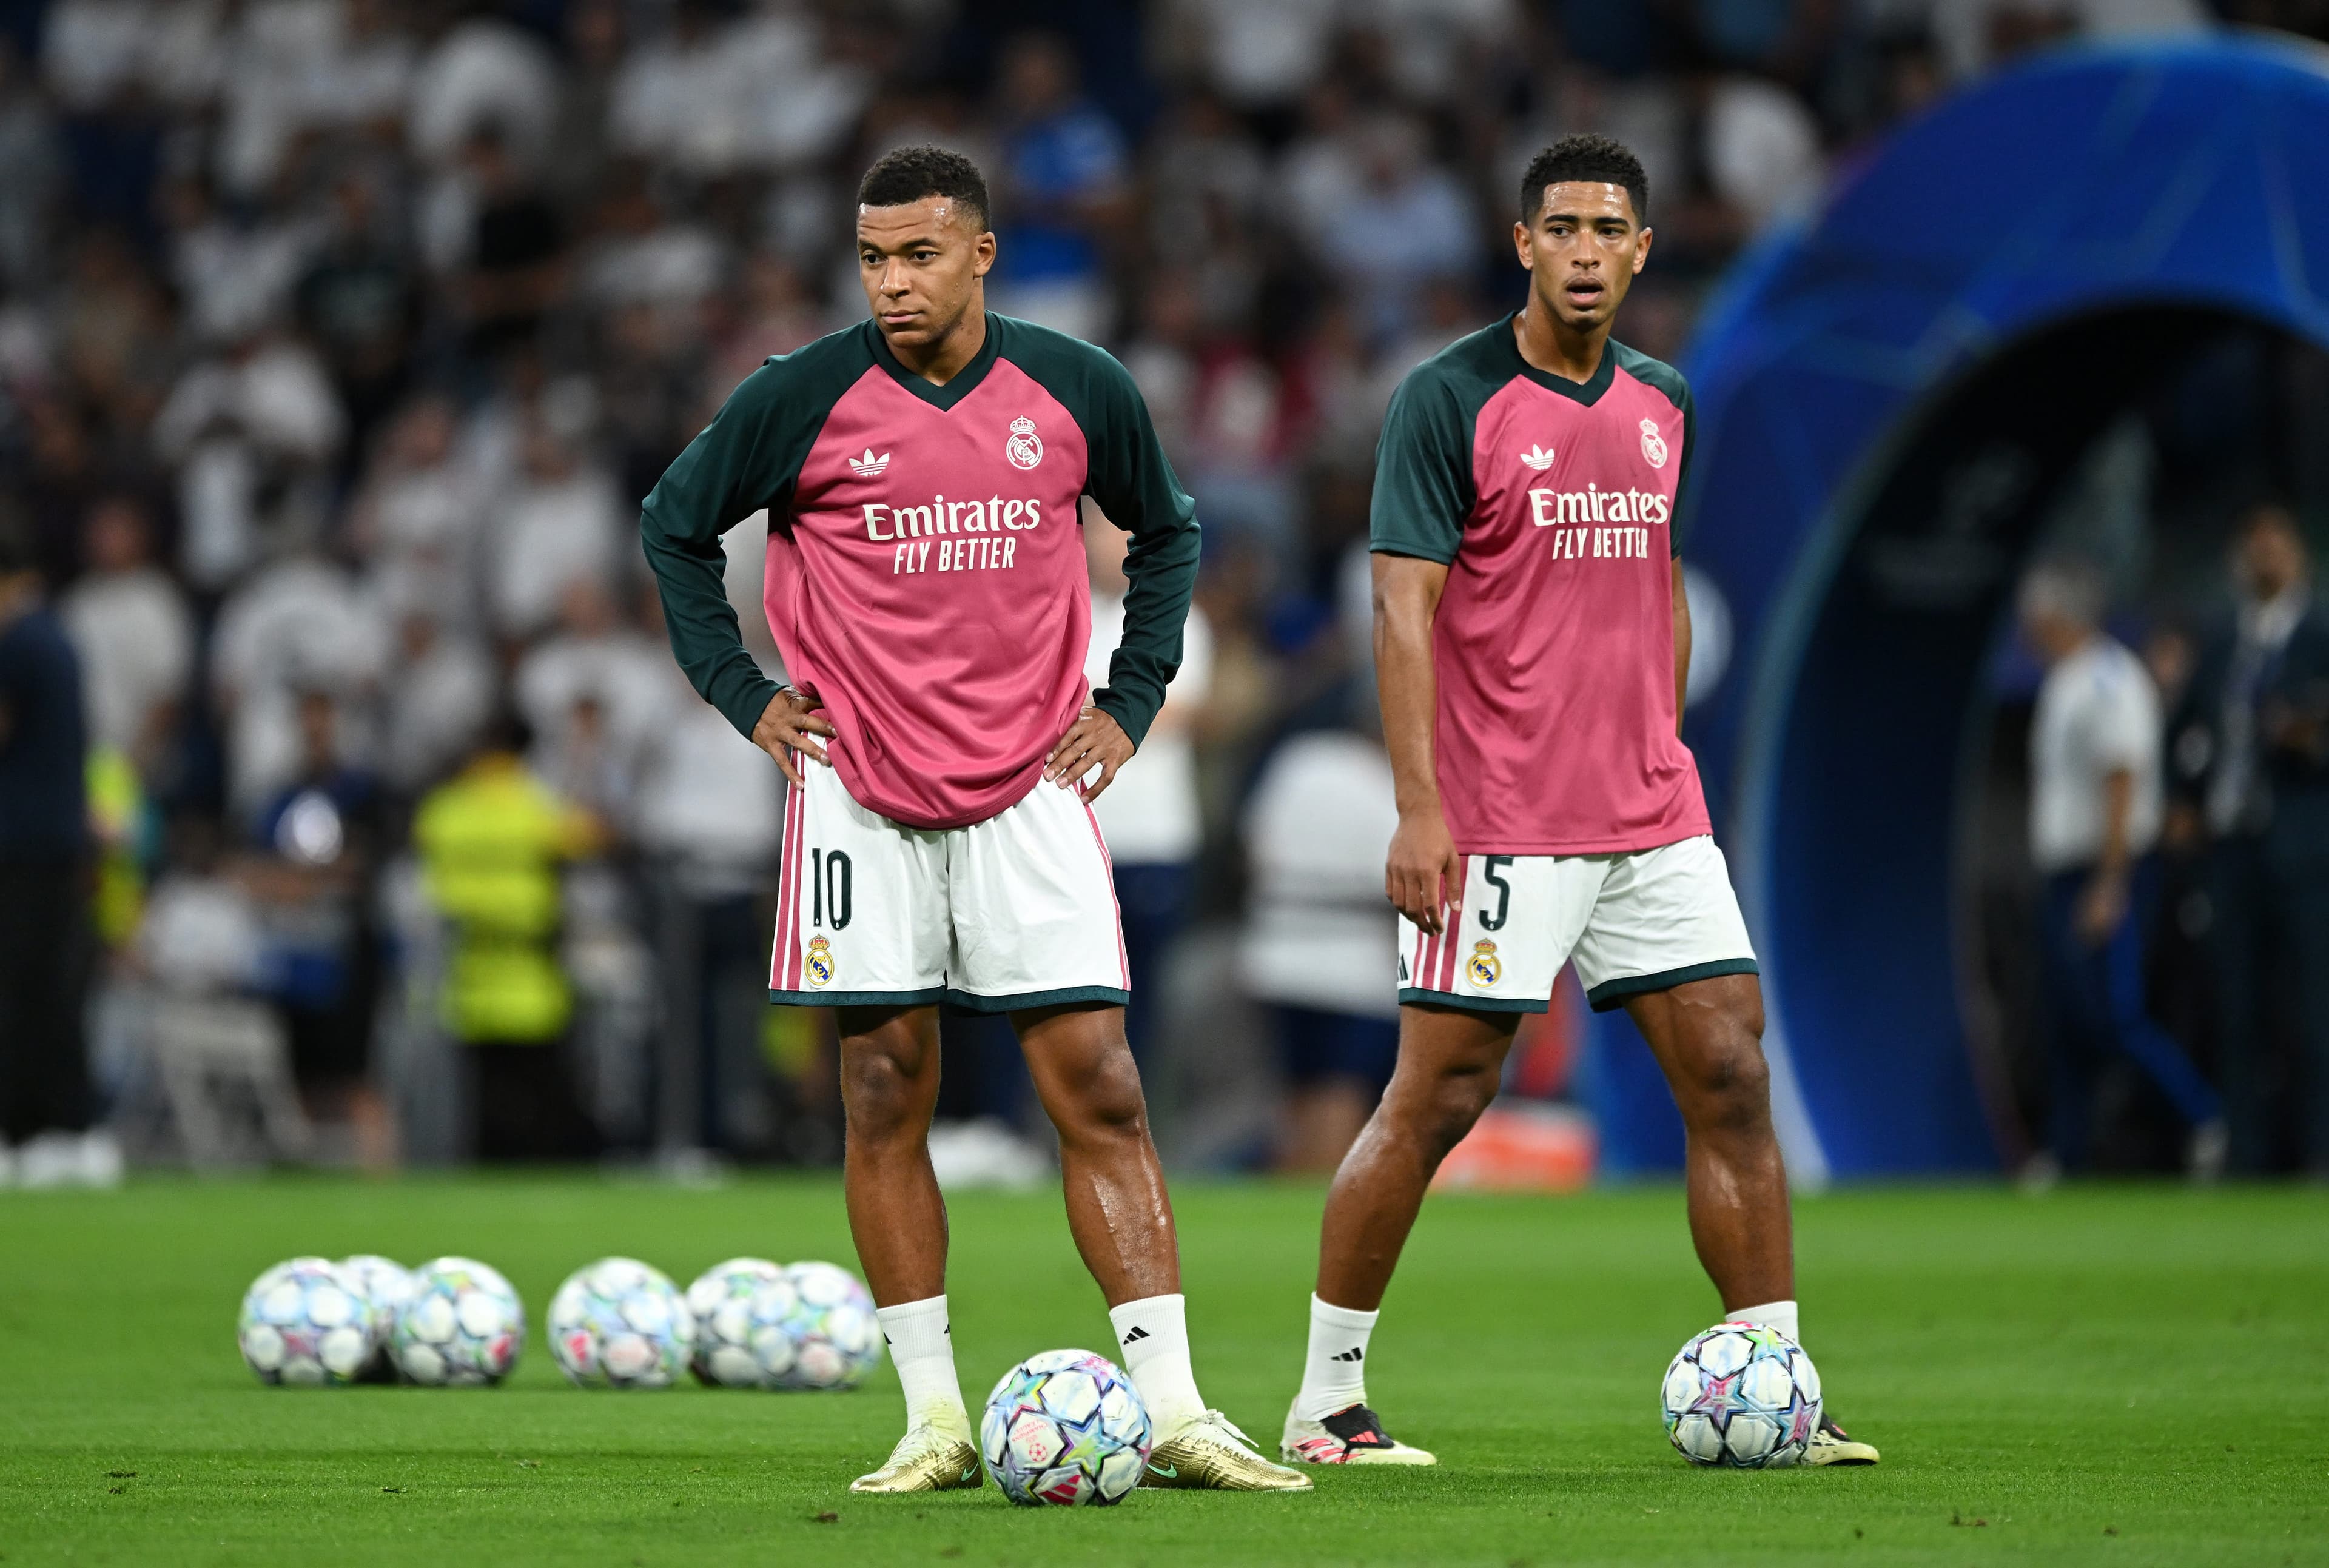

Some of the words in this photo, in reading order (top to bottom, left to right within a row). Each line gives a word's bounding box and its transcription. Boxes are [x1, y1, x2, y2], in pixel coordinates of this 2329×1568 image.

[862, 494, 1040, 541] Emirates
[1527, 482, 1669, 527] Emirates
[893, 539, 931, 574] FLY
[938, 537, 1016, 572] BETTER
[1552, 528, 1588, 560] FLY
[1593, 527, 1648, 559] BETTER
[812, 848, 852, 931] 10
[1479, 855, 1514, 931] 5
[1011, 1421, 1048, 1442] CHAMPIONS
